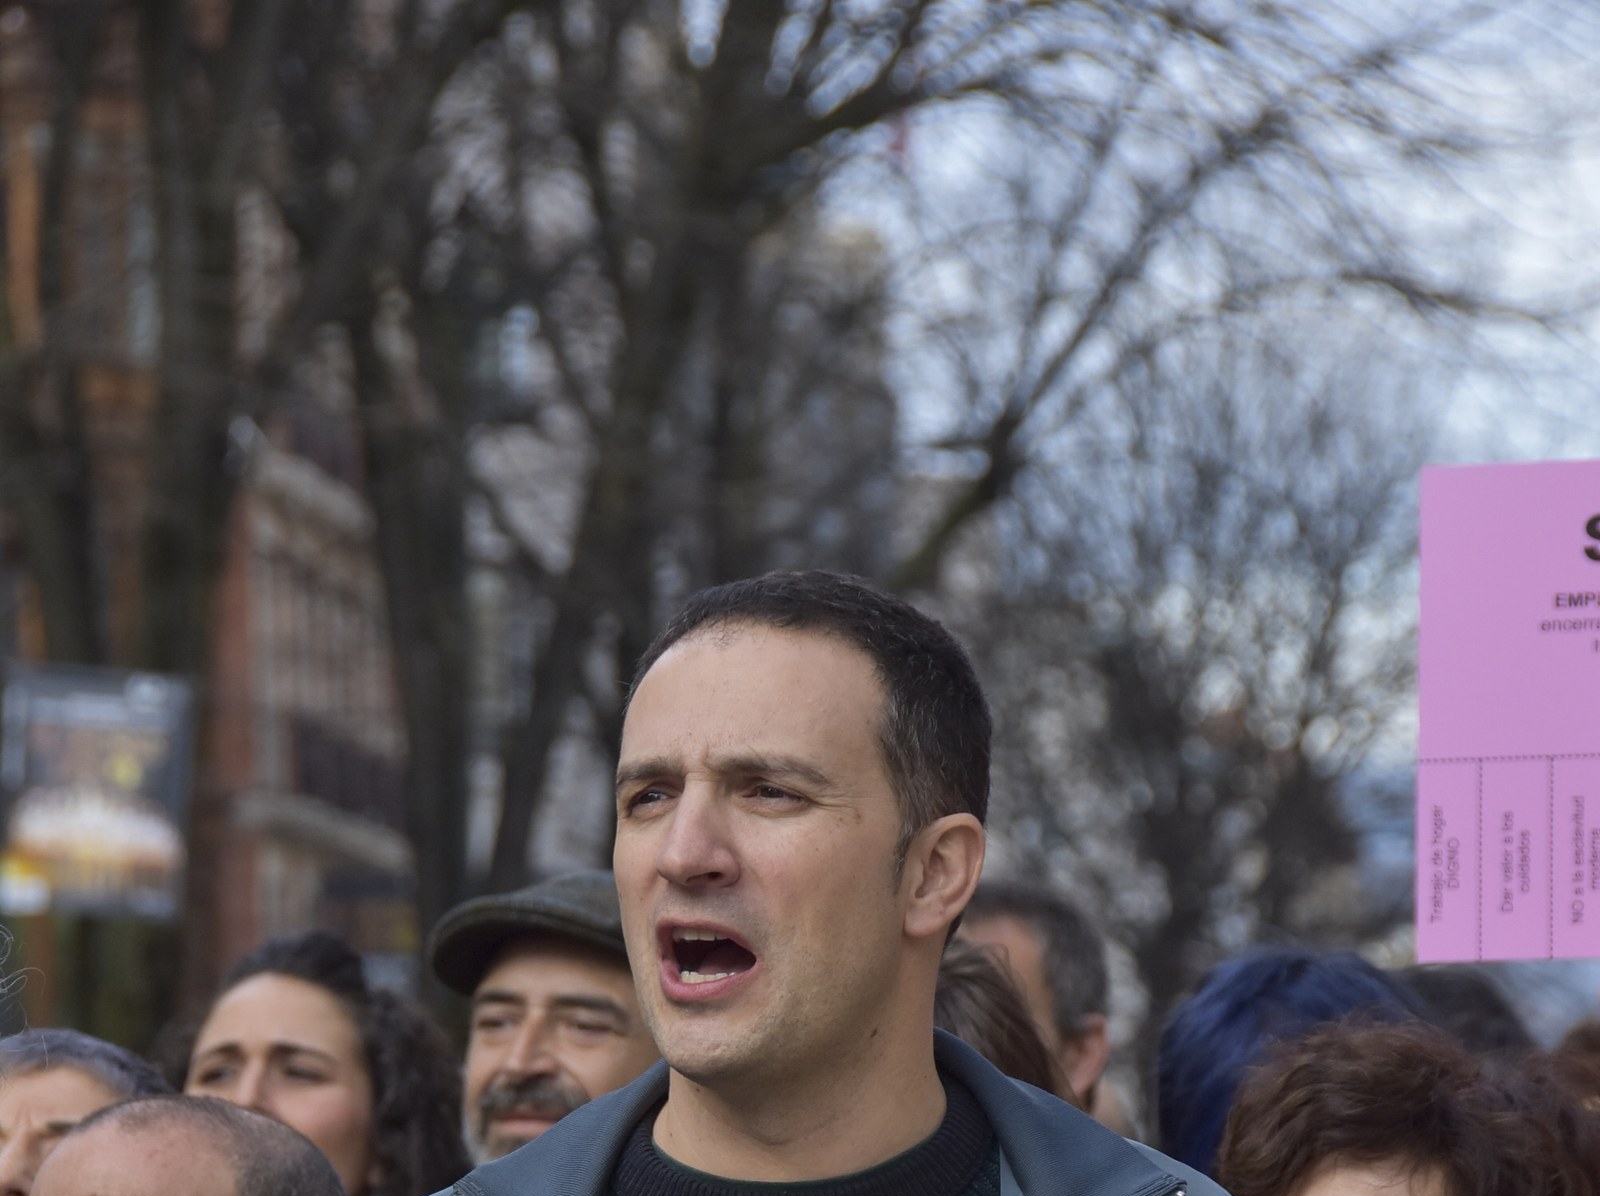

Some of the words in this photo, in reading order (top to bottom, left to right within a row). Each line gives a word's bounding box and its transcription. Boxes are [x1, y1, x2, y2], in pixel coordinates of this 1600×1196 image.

[1432, 805, 1446, 844] hogar
[1502, 812, 1514, 831] los
[1504, 836, 1513, 844] a
[1431, 849, 1443, 866] de
[1447, 838, 1460, 889] DIGNO
[1502, 847, 1513, 882] valor
[1519, 830, 1530, 893] cuidados
[1573, 871, 1584, 883] la
[1431, 871, 1446, 923] Trabajo
[1502, 889, 1514, 912] Dar
[1574, 887, 1584, 895] a
[1572, 900, 1584, 923] NO
